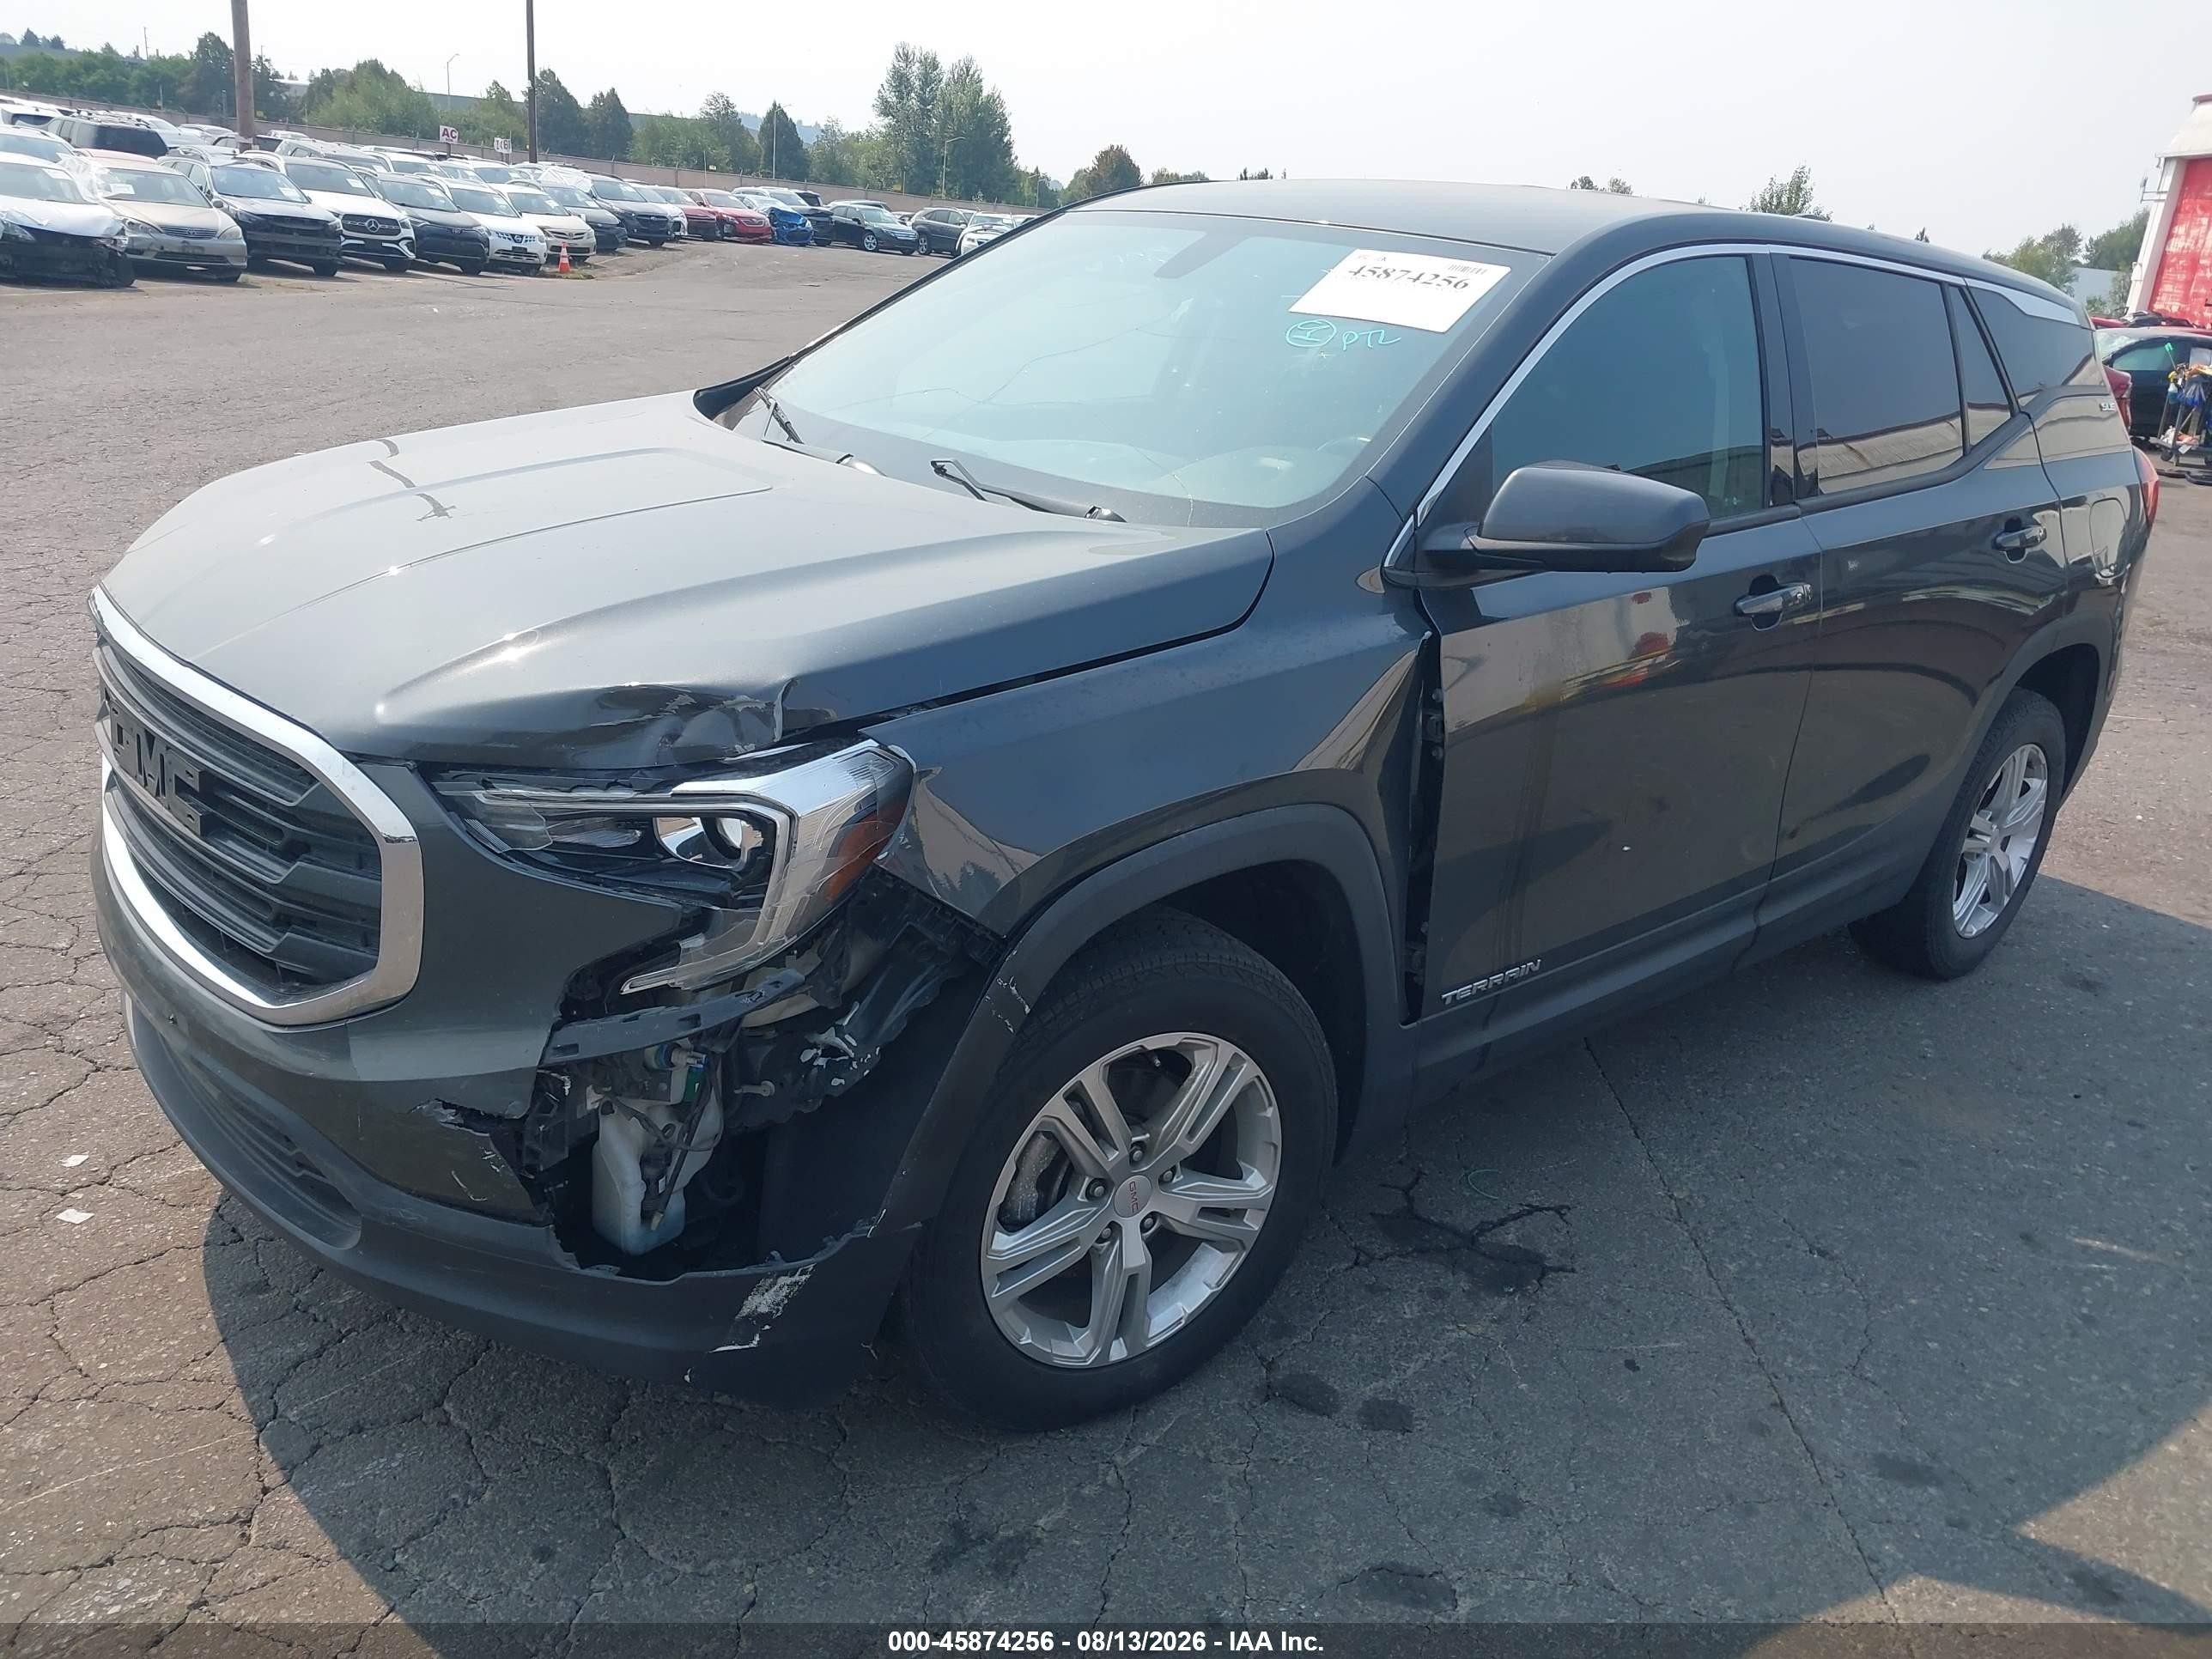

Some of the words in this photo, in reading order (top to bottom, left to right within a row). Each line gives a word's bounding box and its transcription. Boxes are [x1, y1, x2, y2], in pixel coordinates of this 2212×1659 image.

[441, 127, 458, 139] AC
[1348, 264, 1470, 289] 45874256
[1441, 958, 1541, 1006] TERRAIN
[1129, 1181, 1139, 1213] GMC
